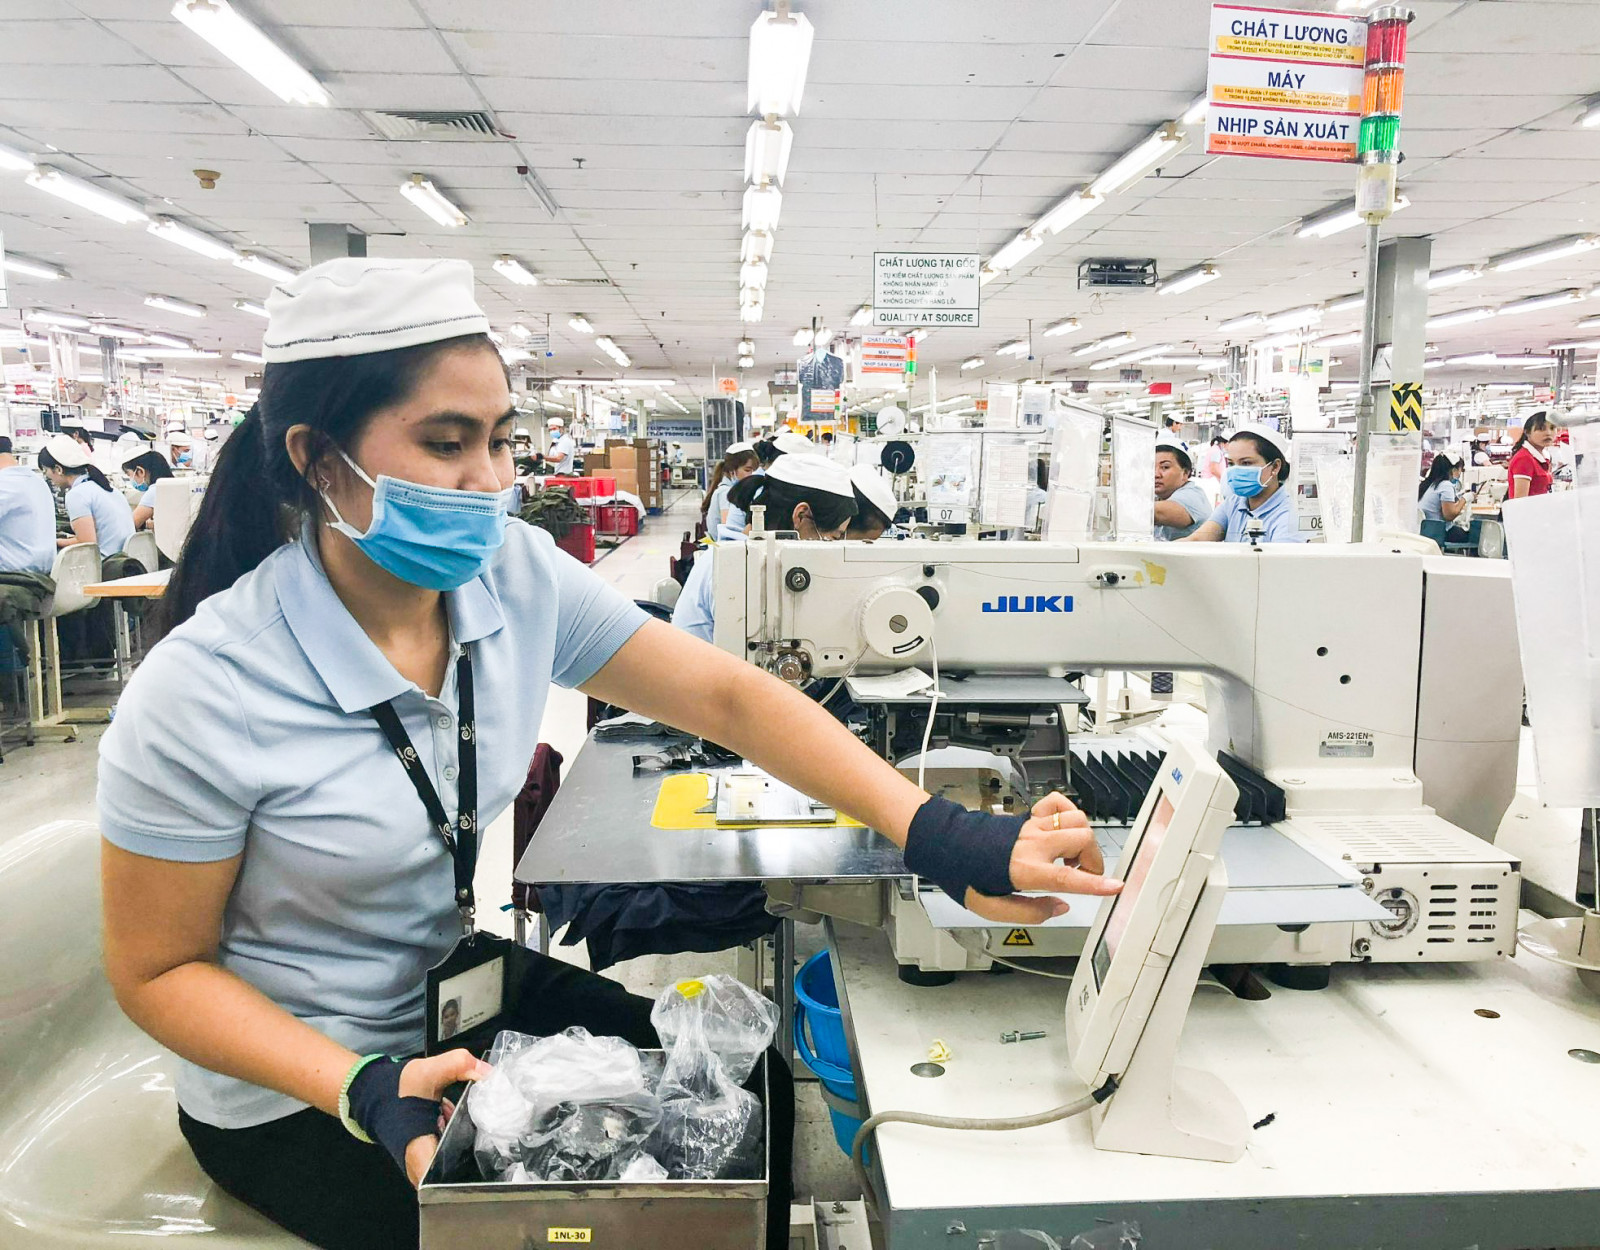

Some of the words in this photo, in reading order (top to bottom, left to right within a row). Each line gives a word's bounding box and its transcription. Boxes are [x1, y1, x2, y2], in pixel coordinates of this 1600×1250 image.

[1231, 18, 1279, 38] CHẤT
[1284, 24, 1348, 44] LƯỢNG
[1268, 69, 1305, 89] MÁY
[1218, 116, 1258, 136] NHỊP
[1263, 117, 1298, 136] SẢN
[1304, 120, 1349, 140] XUẤT
[880, 257, 903, 267] CHẤT
[906, 258, 937, 269] LƯỢNG
[940, 259, 953, 269] TẠI
[880, 313, 918, 321] QUALITY
[922, 313, 933, 322] AT
[935, 314, 974, 322] SOURCE
[940, 510, 953, 520] 07
[982, 596, 1073, 612] JUKI
